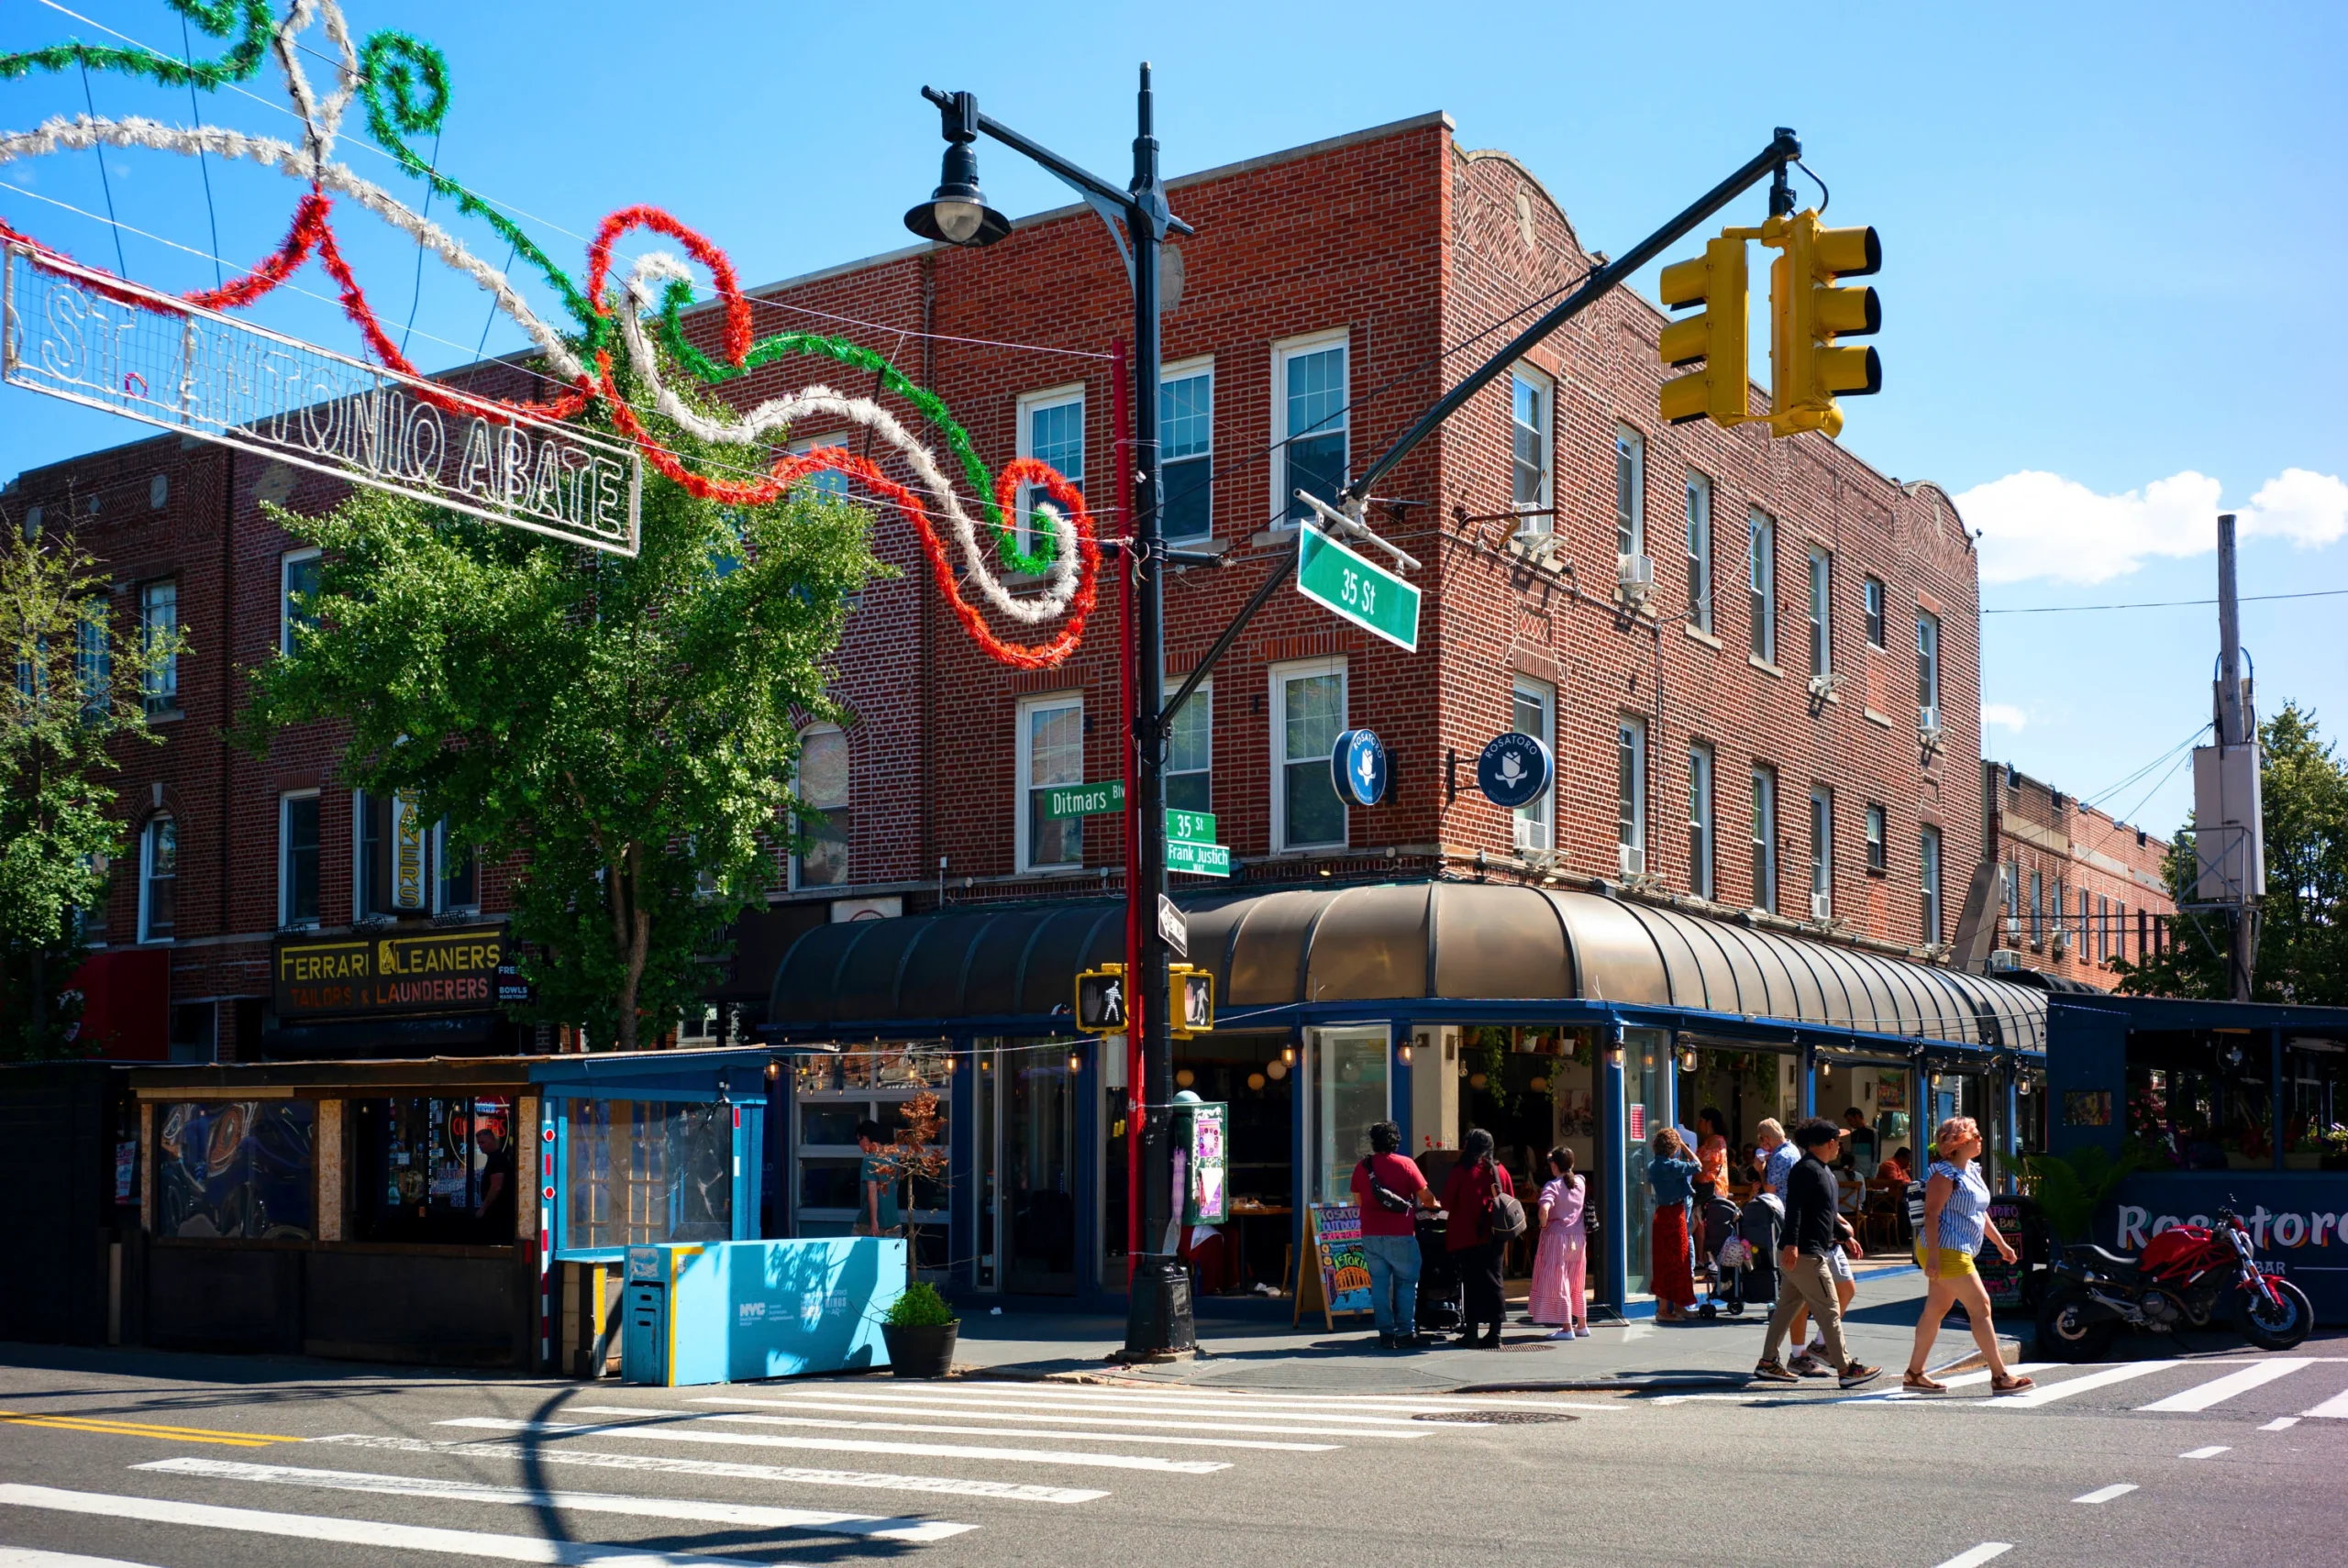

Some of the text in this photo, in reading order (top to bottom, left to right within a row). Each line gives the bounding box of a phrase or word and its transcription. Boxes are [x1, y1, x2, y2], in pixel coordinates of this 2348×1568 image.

[164, 319, 445, 481] ANTONIO
[459, 416, 626, 539] ABATE
[1341, 568, 1376, 615] 35 St
[1353, 734, 1382, 758] ROSATORO
[1485, 735, 1537, 759] ROSATORO
[1053, 784, 1125, 815] Ditmars Blv
[1178, 813, 1204, 838] 35 St
[398, 784, 420, 907] EANERS
[1168, 844, 1228, 867] Frank Justich
[1192, 863, 1205, 872] WAY
[281, 941, 370, 981] FERRARI
[498, 966, 515, 975] FRE
[290, 986, 352, 1008] TAILORS
[376, 977, 488, 1004] LAUNDERERS
[1334, 1253, 1368, 1272] ASTORIA
[739, 1302, 766, 1317] NYC
